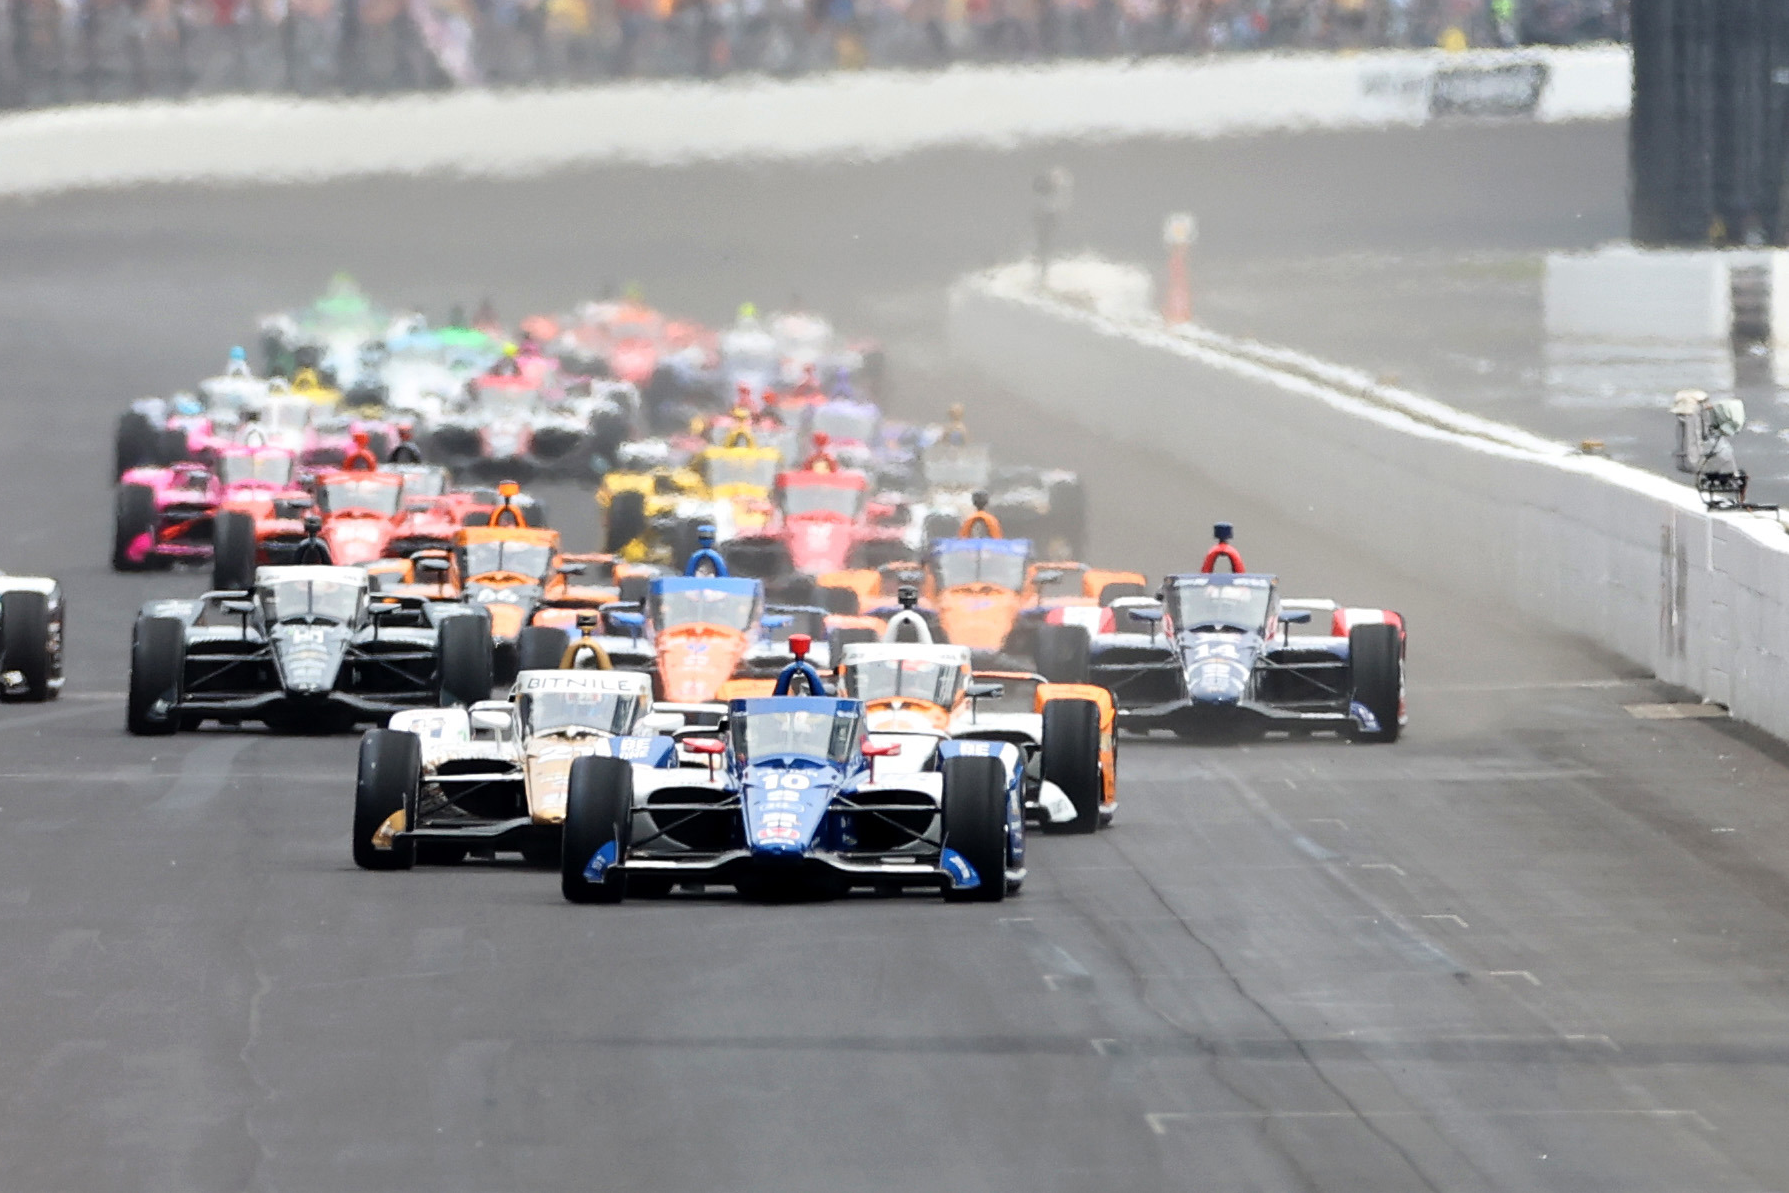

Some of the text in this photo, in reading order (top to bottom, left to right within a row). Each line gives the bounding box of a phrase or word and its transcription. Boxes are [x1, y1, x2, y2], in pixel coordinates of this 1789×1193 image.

[1194, 644, 1240, 660] 14
[526, 677, 632, 692] BITNILE
[761, 773, 810, 790] 10
